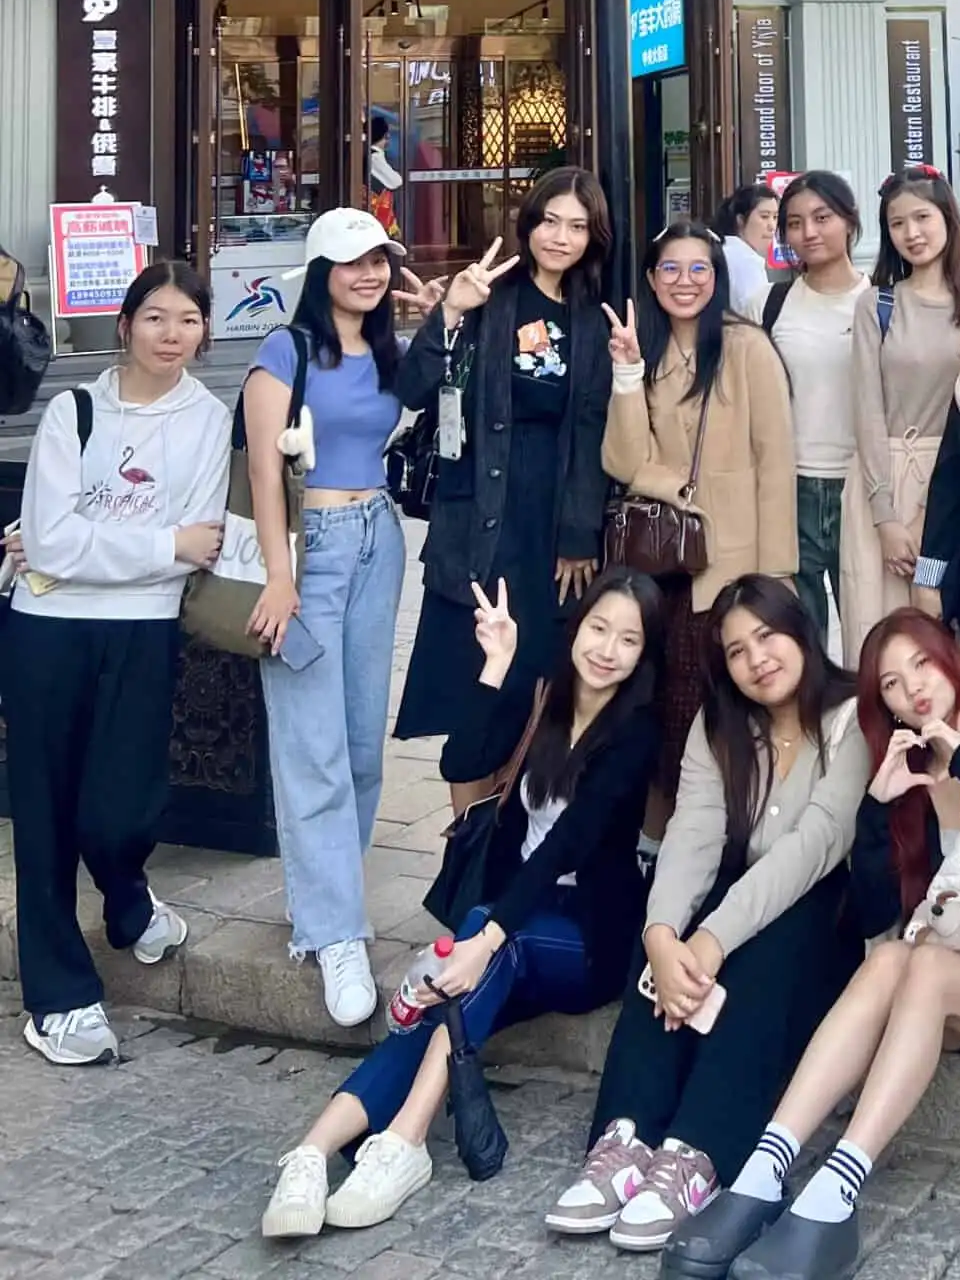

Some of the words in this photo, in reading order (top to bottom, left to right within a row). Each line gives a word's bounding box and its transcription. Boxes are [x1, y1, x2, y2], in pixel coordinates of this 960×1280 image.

[752, 50, 774, 66] of
[901, 39, 923, 113] Restaurant
[754, 72, 776, 105] floor
[754, 107, 777, 156] second
